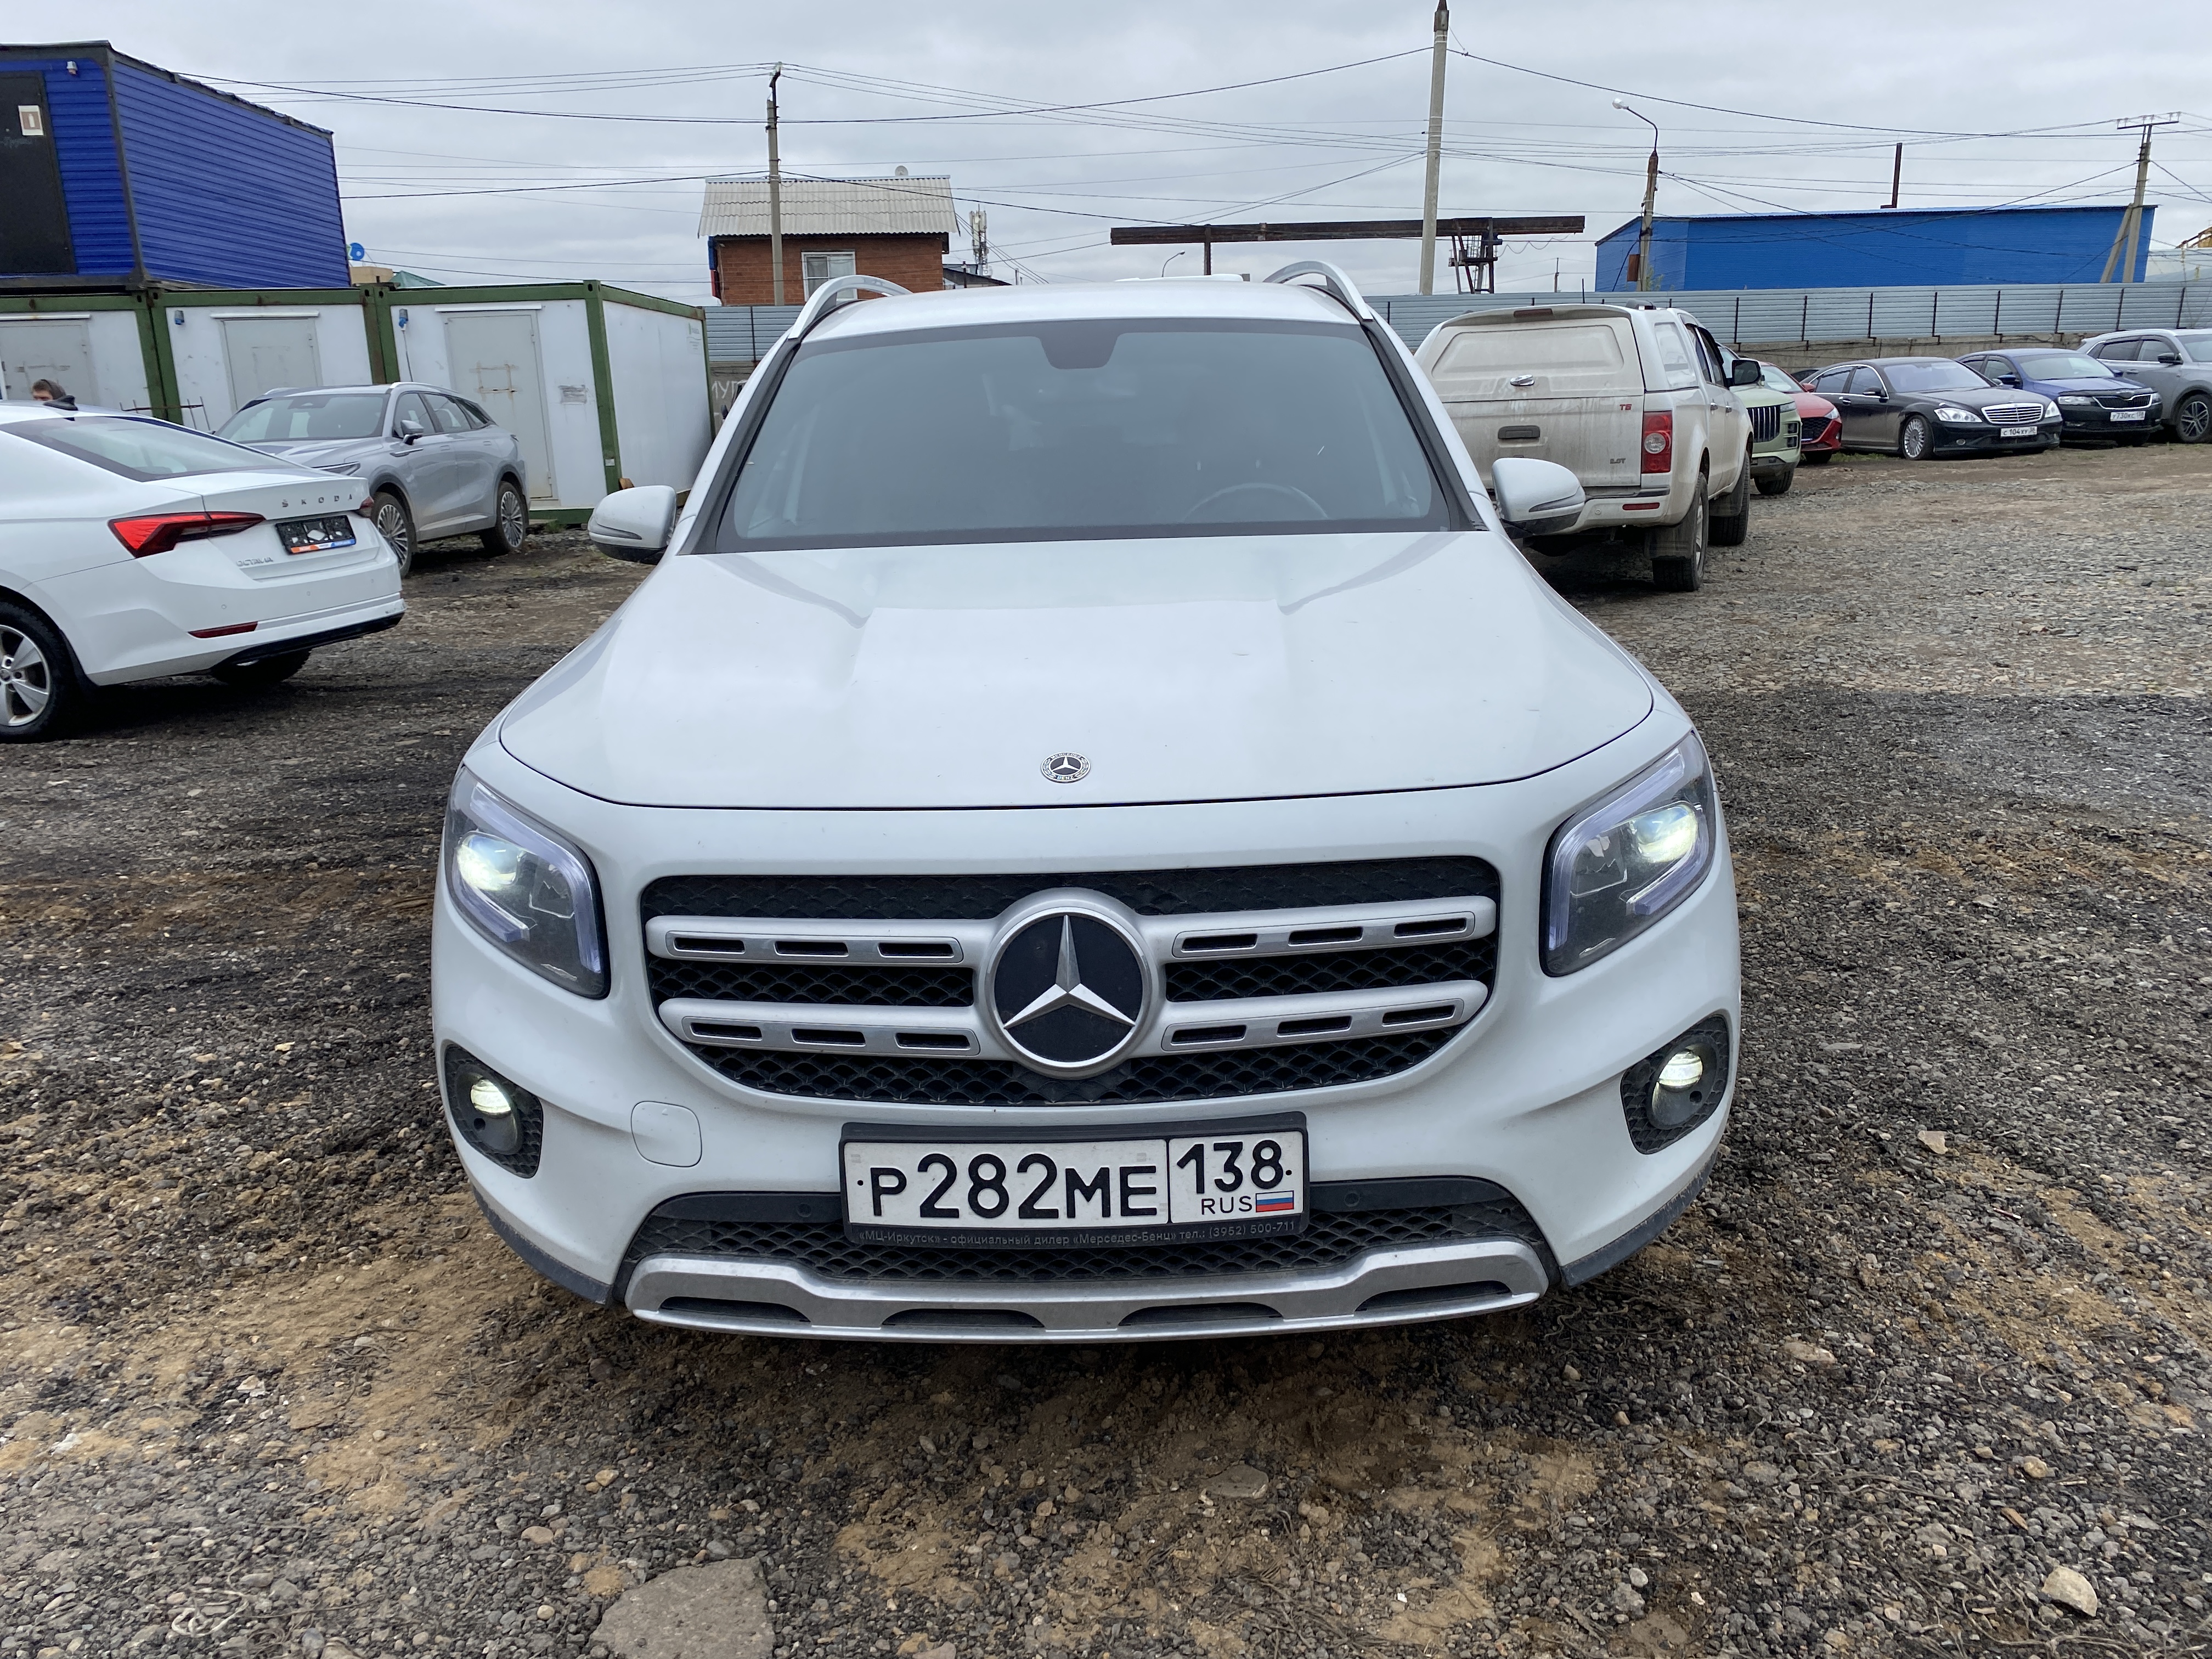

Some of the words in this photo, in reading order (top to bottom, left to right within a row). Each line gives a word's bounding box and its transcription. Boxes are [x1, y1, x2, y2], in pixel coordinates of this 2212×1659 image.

[236, 557, 274, 567] OCTAVIA
[870, 1153, 1157, 1218] Р282МЕ
[1177, 1139, 1284, 1194] 138
[1201, 1196, 1252, 1215] RUS
[951, 1234, 1031, 1246] официальный
[1034, 1236, 1069, 1246] дилер
[1209, 1224, 1246, 1239] (3952)
[1250, 1221, 1295, 1234] 500-711
